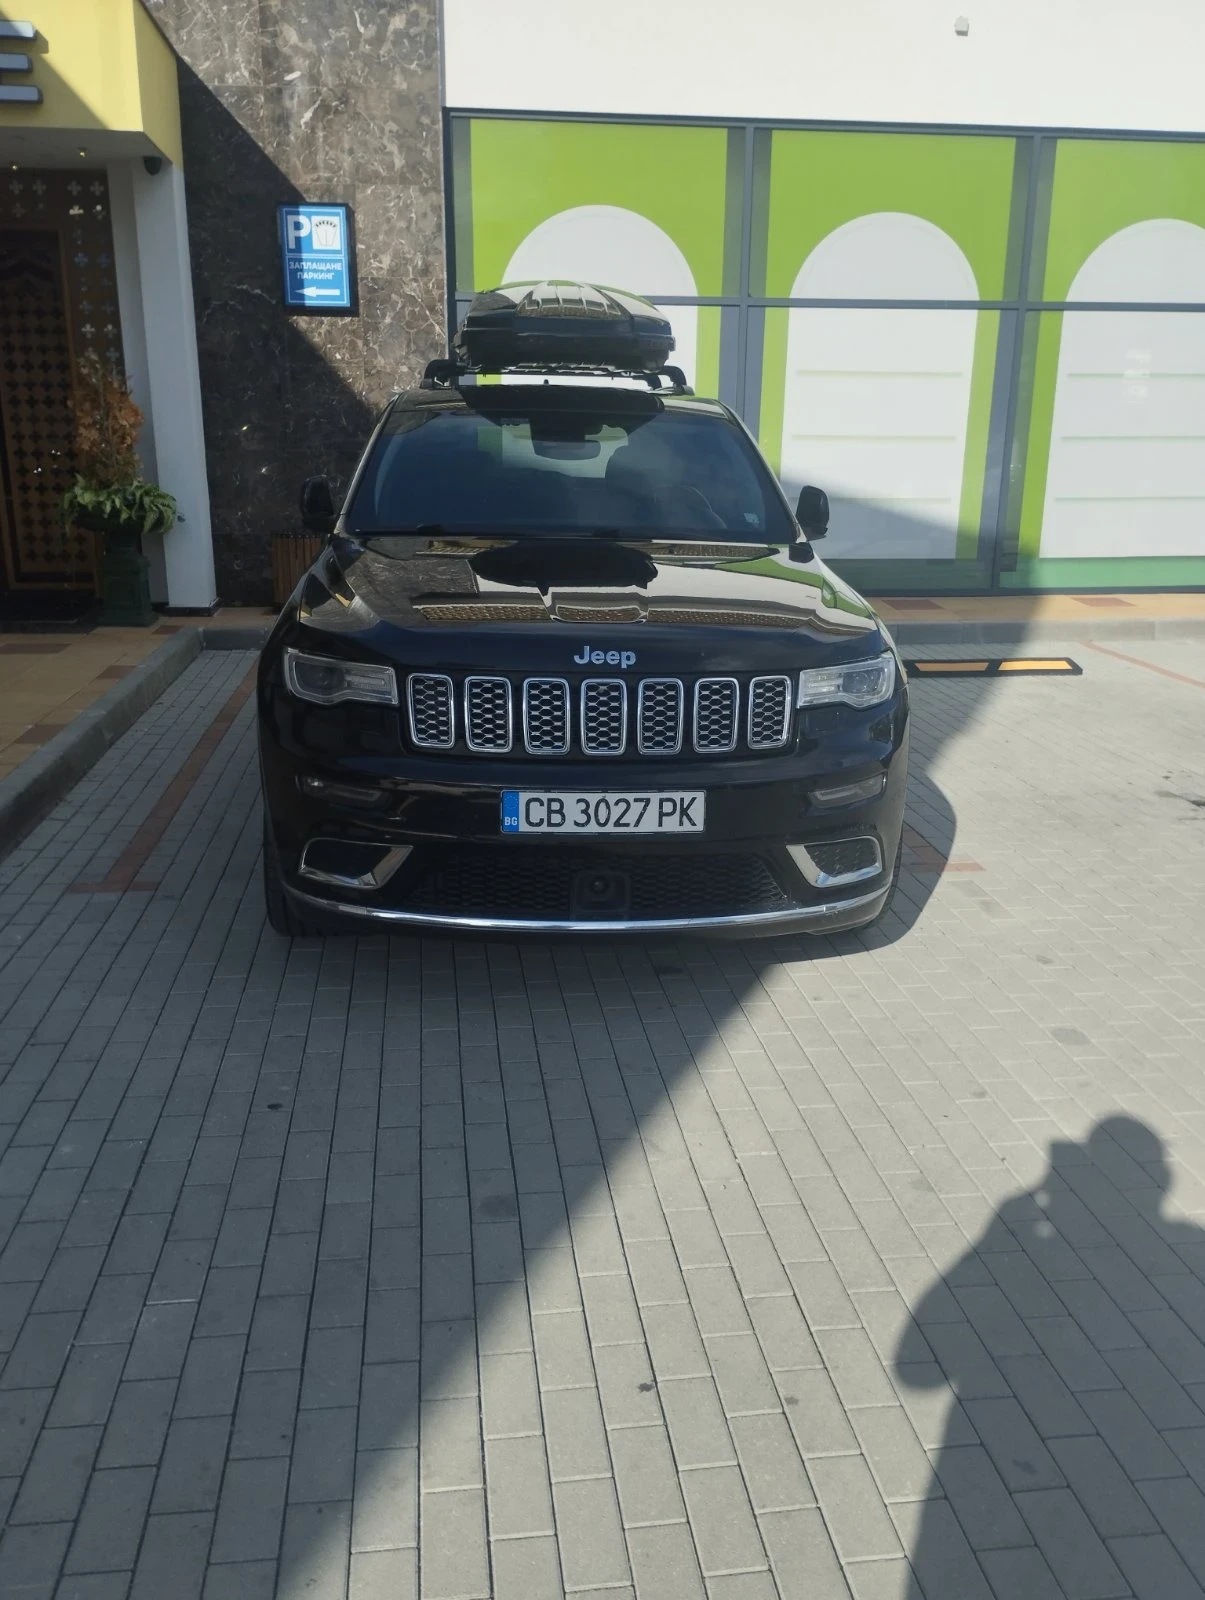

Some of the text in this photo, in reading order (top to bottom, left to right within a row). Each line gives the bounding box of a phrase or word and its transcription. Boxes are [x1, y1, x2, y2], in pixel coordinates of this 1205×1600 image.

[287, 215, 311, 249] P
[289, 261, 342, 271] ЗАПЛАЩАНЕ
[297, 271, 335, 280] ПАРКИНГ
[574, 645, 636, 668] Jeep
[504, 797, 697, 827] BG CB 3027 PK
